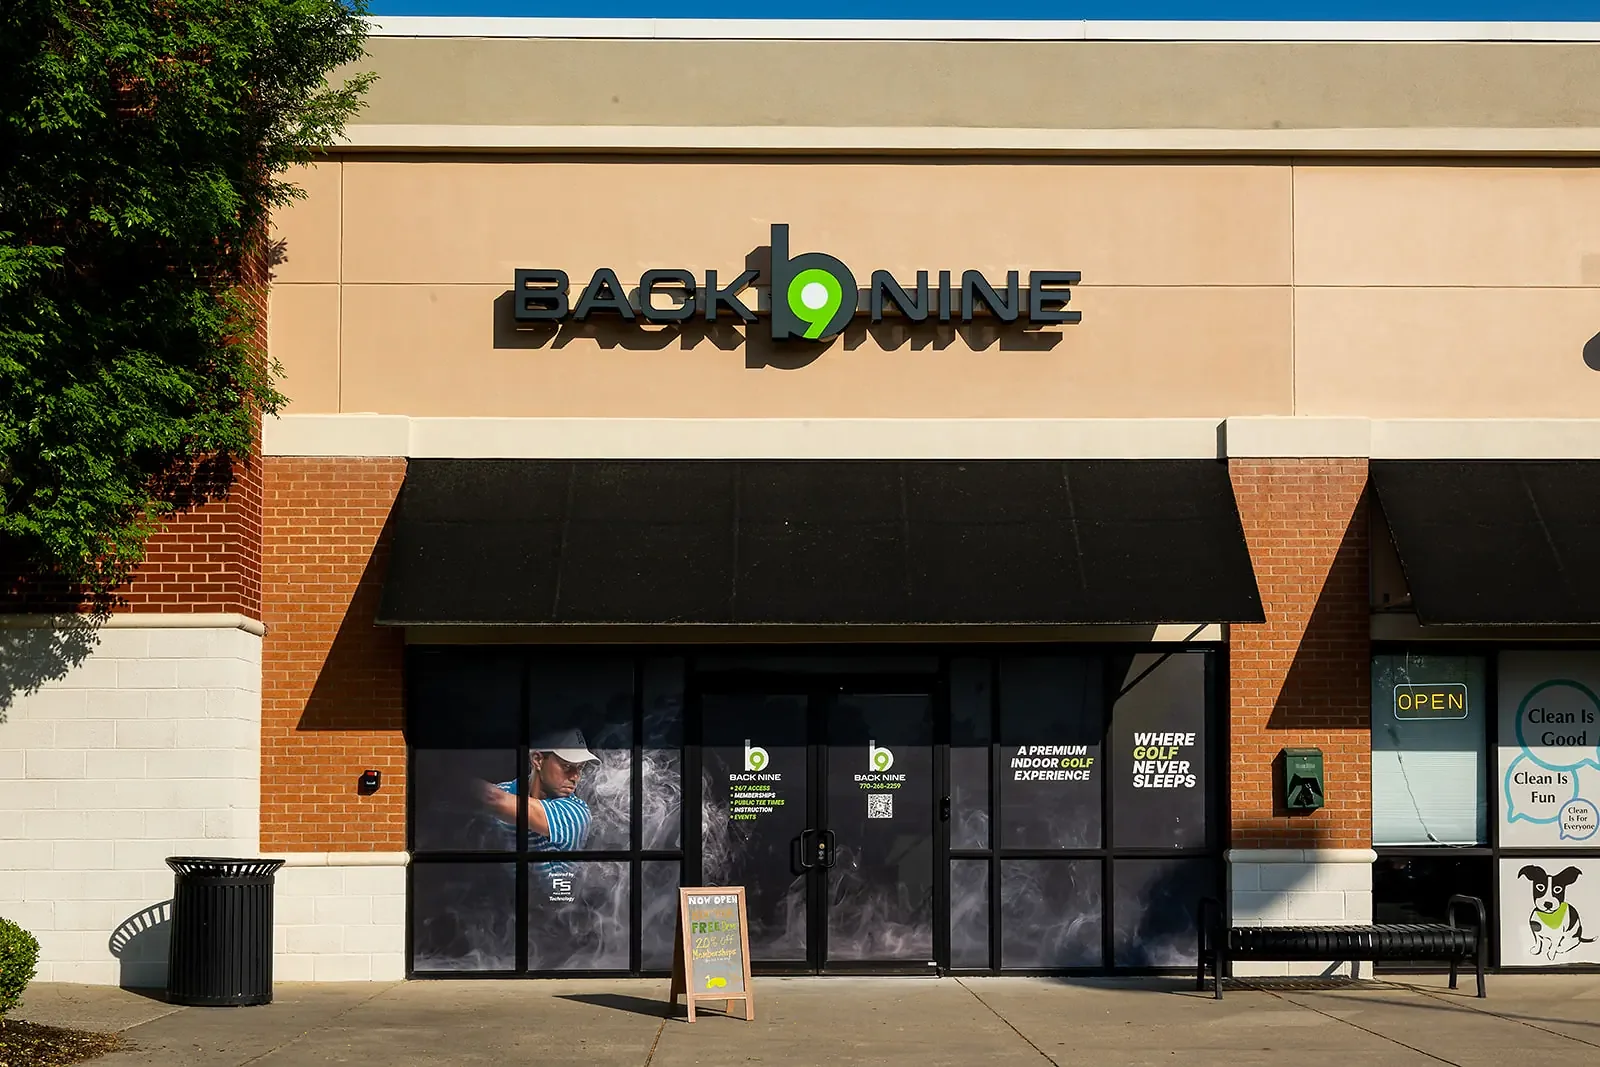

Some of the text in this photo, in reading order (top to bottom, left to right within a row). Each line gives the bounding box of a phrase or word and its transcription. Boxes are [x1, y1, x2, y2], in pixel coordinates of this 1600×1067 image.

[514, 268, 759, 321] BACK
[871, 270, 1082, 323] NINE
[1398, 693, 1463, 710] OPEN
[1528, 708, 1594, 724] Clean Is
[1134, 732, 1196, 746] WHERE
[1541, 731, 1587, 746] Good
[1017, 746, 1087, 756] A PREMIUM
[1133, 746, 1178, 760] GOLF
[1010, 758, 1094, 768] INDOOR GOLF
[1132, 761, 1190, 774] NEVER
[1014, 770, 1090, 780] EXPERIENCE
[1132, 774, 1196, 788] SLEEPS
[1514, 772, 1568, 785] Clean Is
[1531, 791, 1556, 803] Fun
[1568, 806, 1588, 814] Clean
[1563, 822, 1595, 832] Everyone
[553, 879, 571, 891] FS
[688, 895, 737, 905] NOW OPEN
[692, 922, 720, 933] FREE
